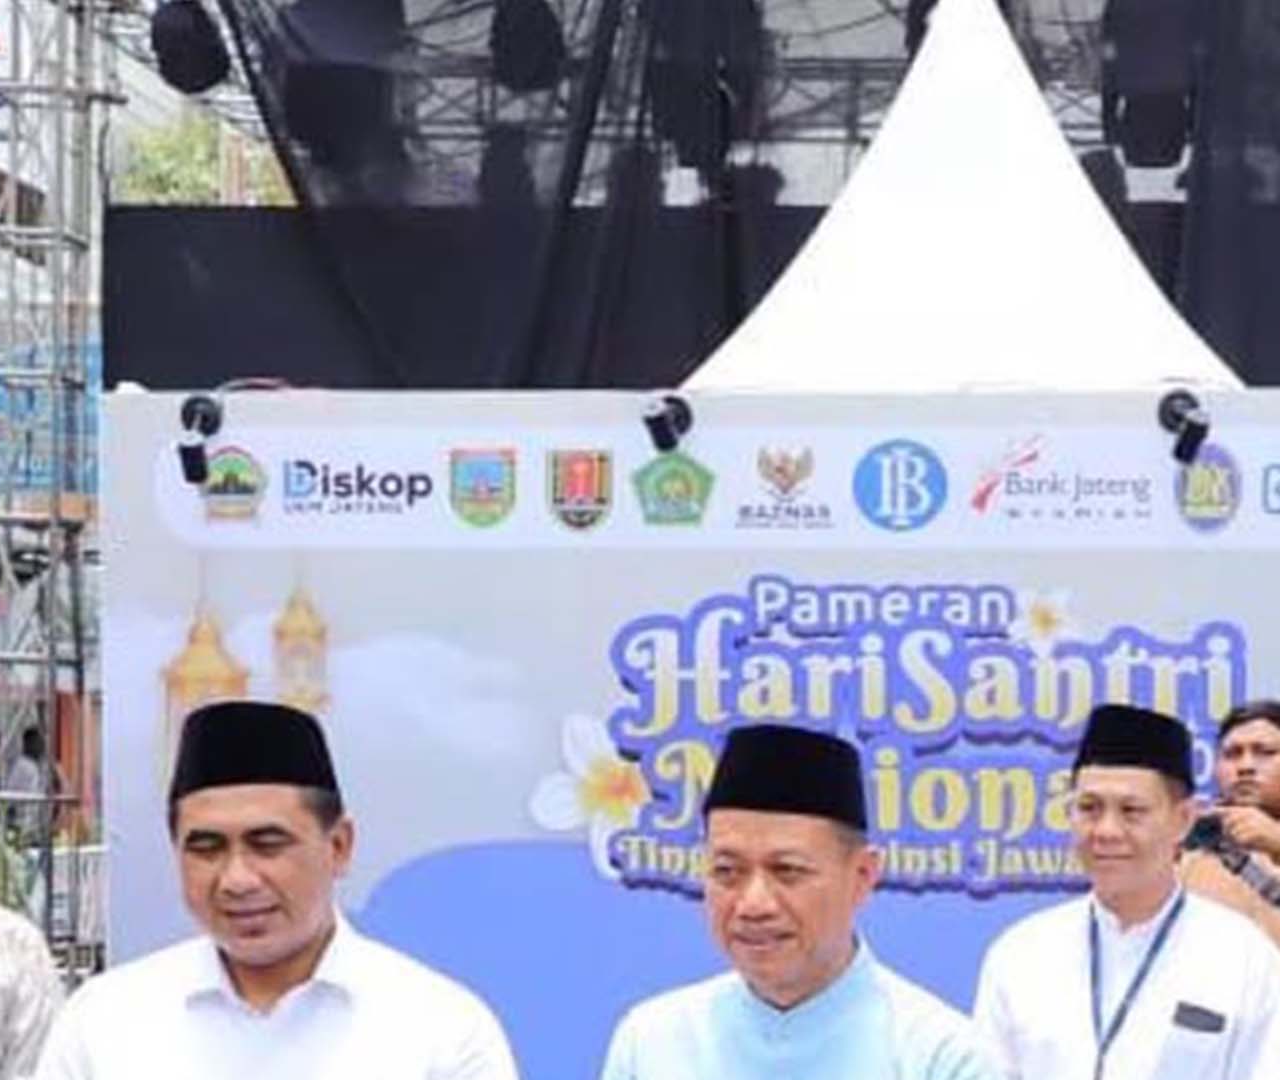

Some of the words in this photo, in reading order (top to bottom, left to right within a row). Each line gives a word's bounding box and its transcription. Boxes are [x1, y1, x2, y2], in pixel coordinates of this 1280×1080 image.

[283, 460, 433, 507] Diskop
[1005, 470, 1070, 496] Bank
[755, 581, 1012, 628] Pameran
